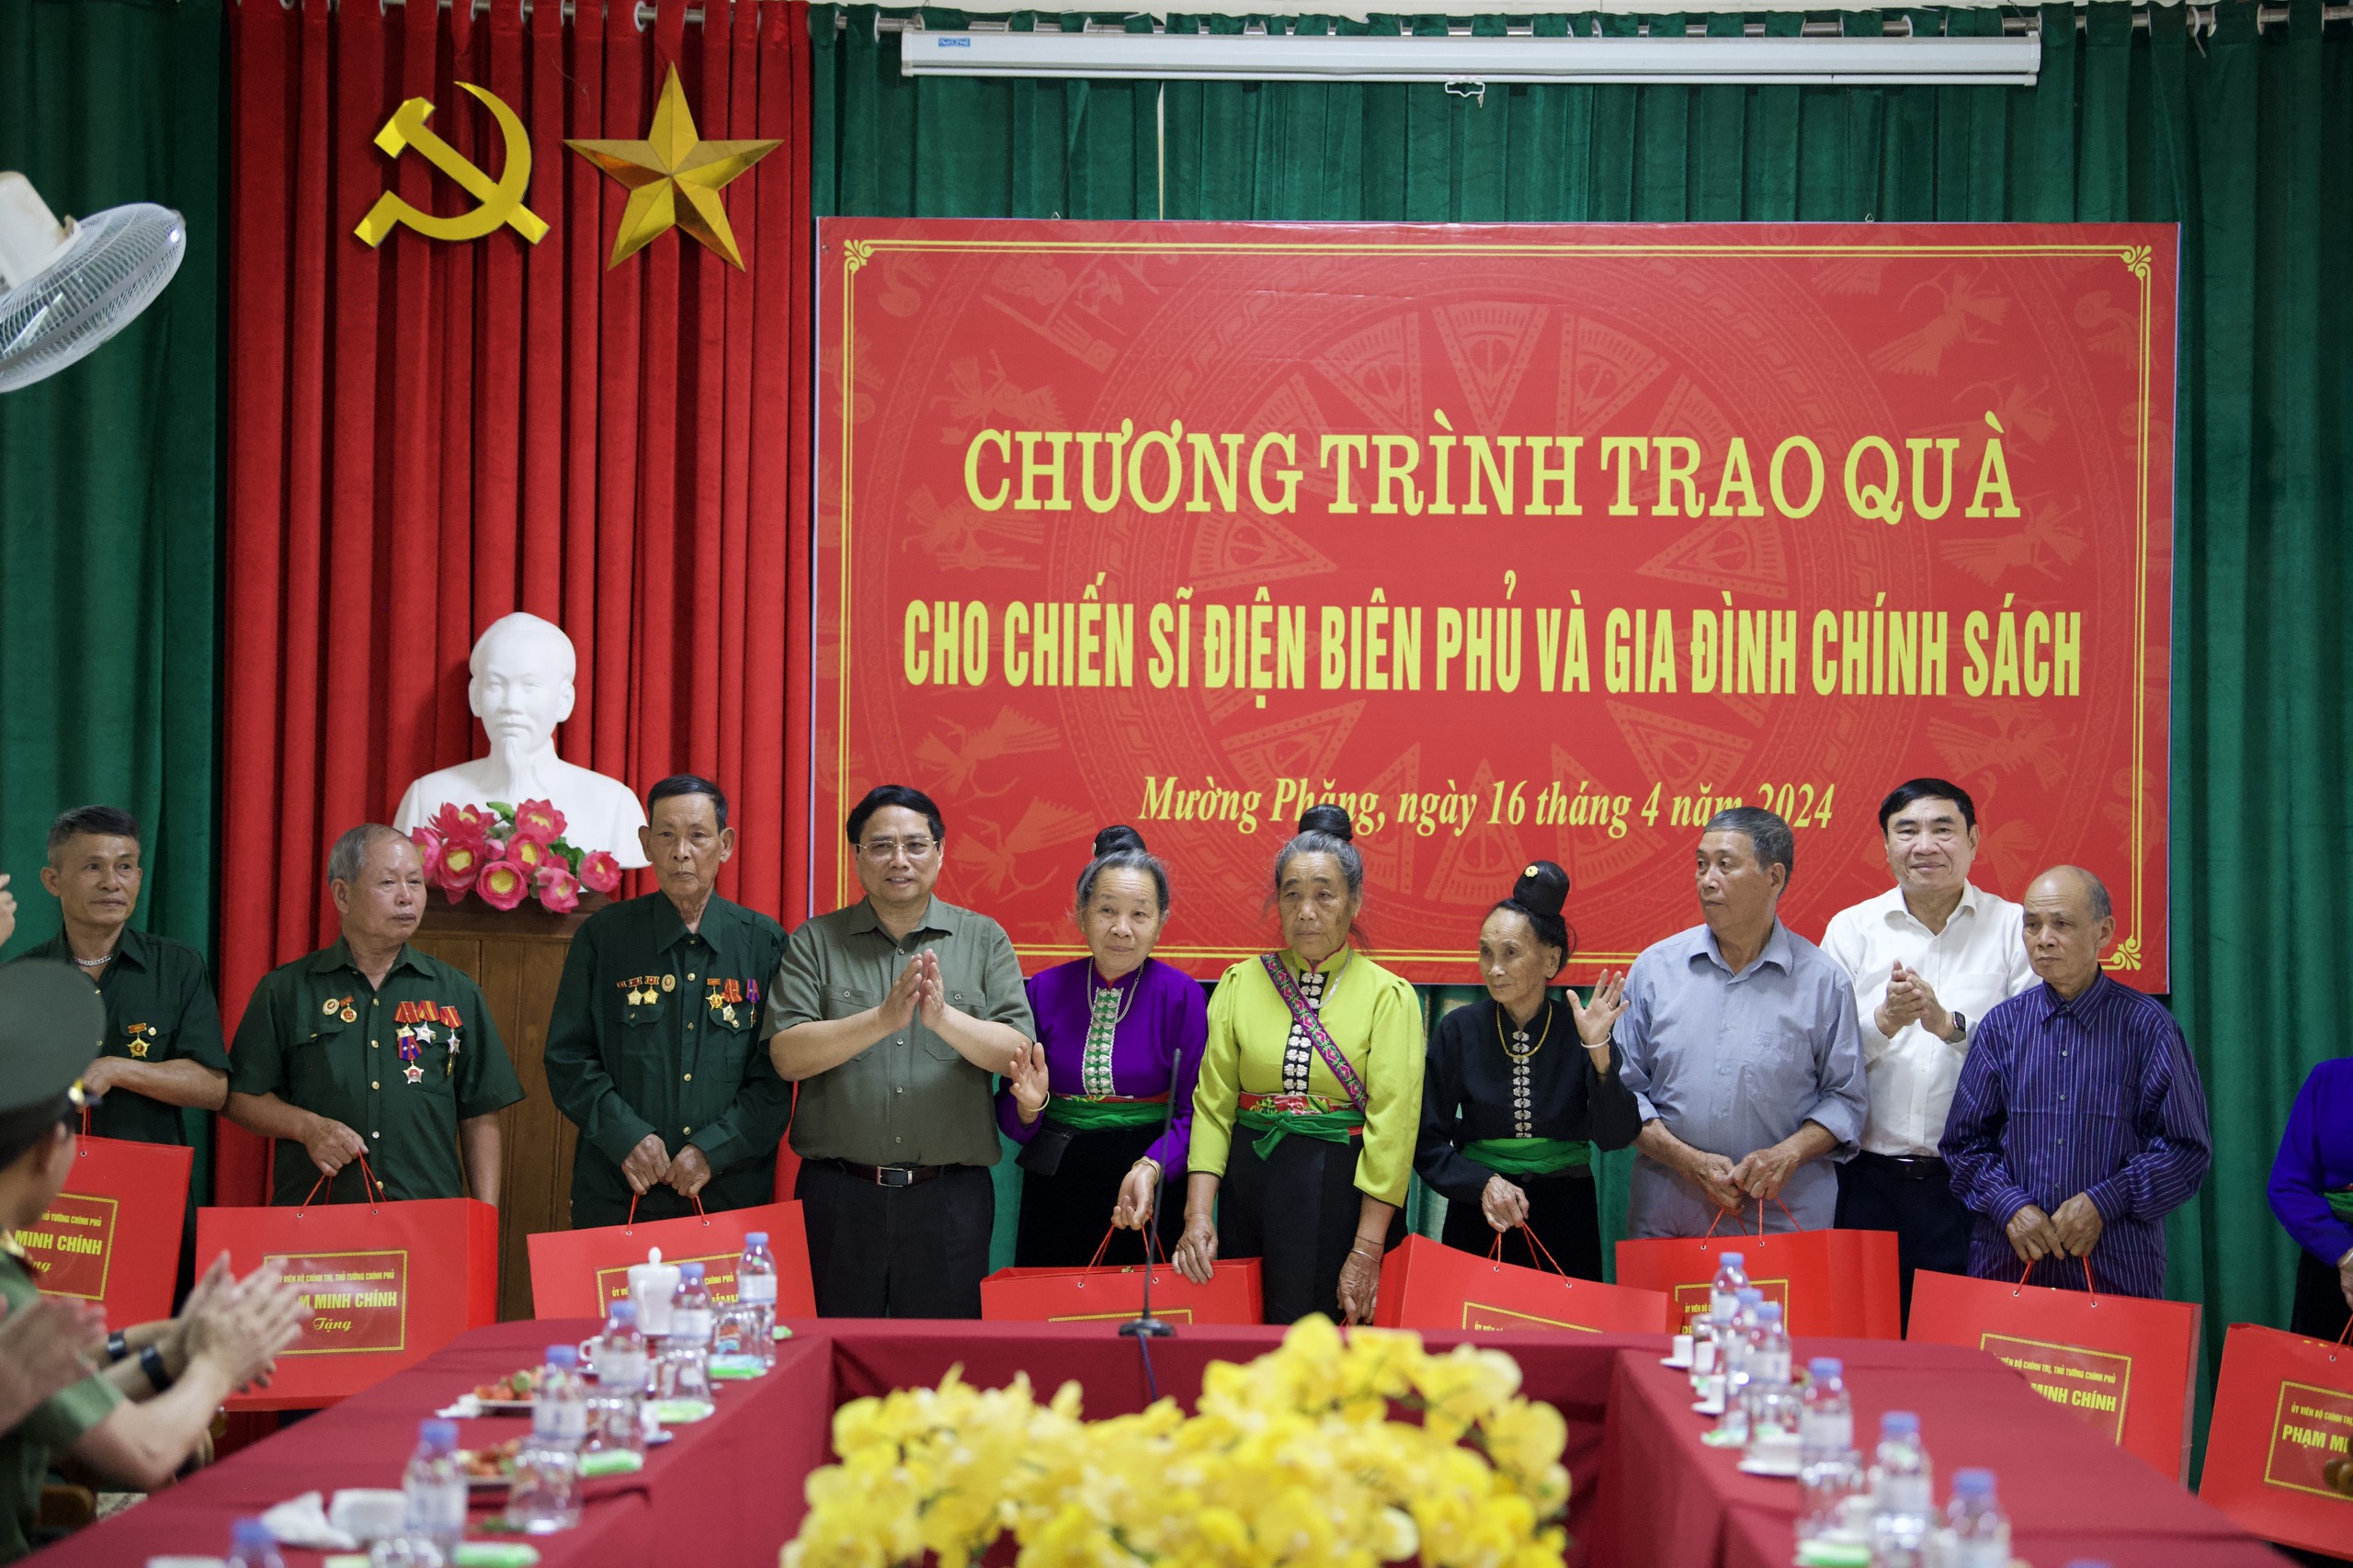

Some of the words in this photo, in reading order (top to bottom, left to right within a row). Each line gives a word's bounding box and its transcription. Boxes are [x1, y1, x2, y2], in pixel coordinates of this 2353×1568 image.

[964, 418, 1303, 515] CHƯƠNG
[1321, 409, 1583, 517] TRÌNH
[1601, 436, 1824, 519] TRAO
[1844, 410, 2021, 525] QUÀ
[904, 600, 989, 687] CHO
[1004, 572, 1134, 687] CHIẾN
[1148, 586, 1193, 688] SĨ
[1204, 585, 1306, 709] ĐIỆN
[1320, 587, 1422, 691] BIÊN
[1436, 570, 1522, 693] PHỦ
[1536, 589, 1590, 692] VÀ
[1604, 608, 1677, 694] GIA
[1689, 591, 1797, 695] ĐÌNH
[1812, 592, 1948, 696] CHÍNH
[1962, 593, 2081, 698] SÁCH
[1137, 776, 1263, 835] Mường
[1397, 779, 1478, 836] ngày
[1486, 779, 1528, 824] 16
[1535, 780, 1632, 838] tháng
[1641, 781, 1662, 826] 4
[1758, 782, 1836, 828] 2024
[14, 1230, 53, 1249] MINH
[57, 1234, 103, 1256] CHÍNH
[365, 1270, 382, 1280] CHÍNH
[382, 1268, 395, 1279] PHỦ
[313, 1292, 351, 1309] MINH
[355, 1289, 398, 1308] CHÍNH
[313, 1317, 353, 1333] Tặng
[2023, 1360, 2040, 1371] CHÍNH
[2053, 1364, 2065, 1376] THỦ
[2085, 1370, 2104, 1382] CHÍNH
[2103, 1372, 2117, 1384] PHỦ
[2071, 1390, 2117, 1413] CHÍNH
[2301, 1406, 2314, 1416] VIÊN
[2314, 1409, 2324, 1421] BỘ
[2324, 1412, 2342, 1423] CHÍNH
[2282, 1424, 2327, 1449] PHẠM
[2329, 1434, 2348, 1453] MI
